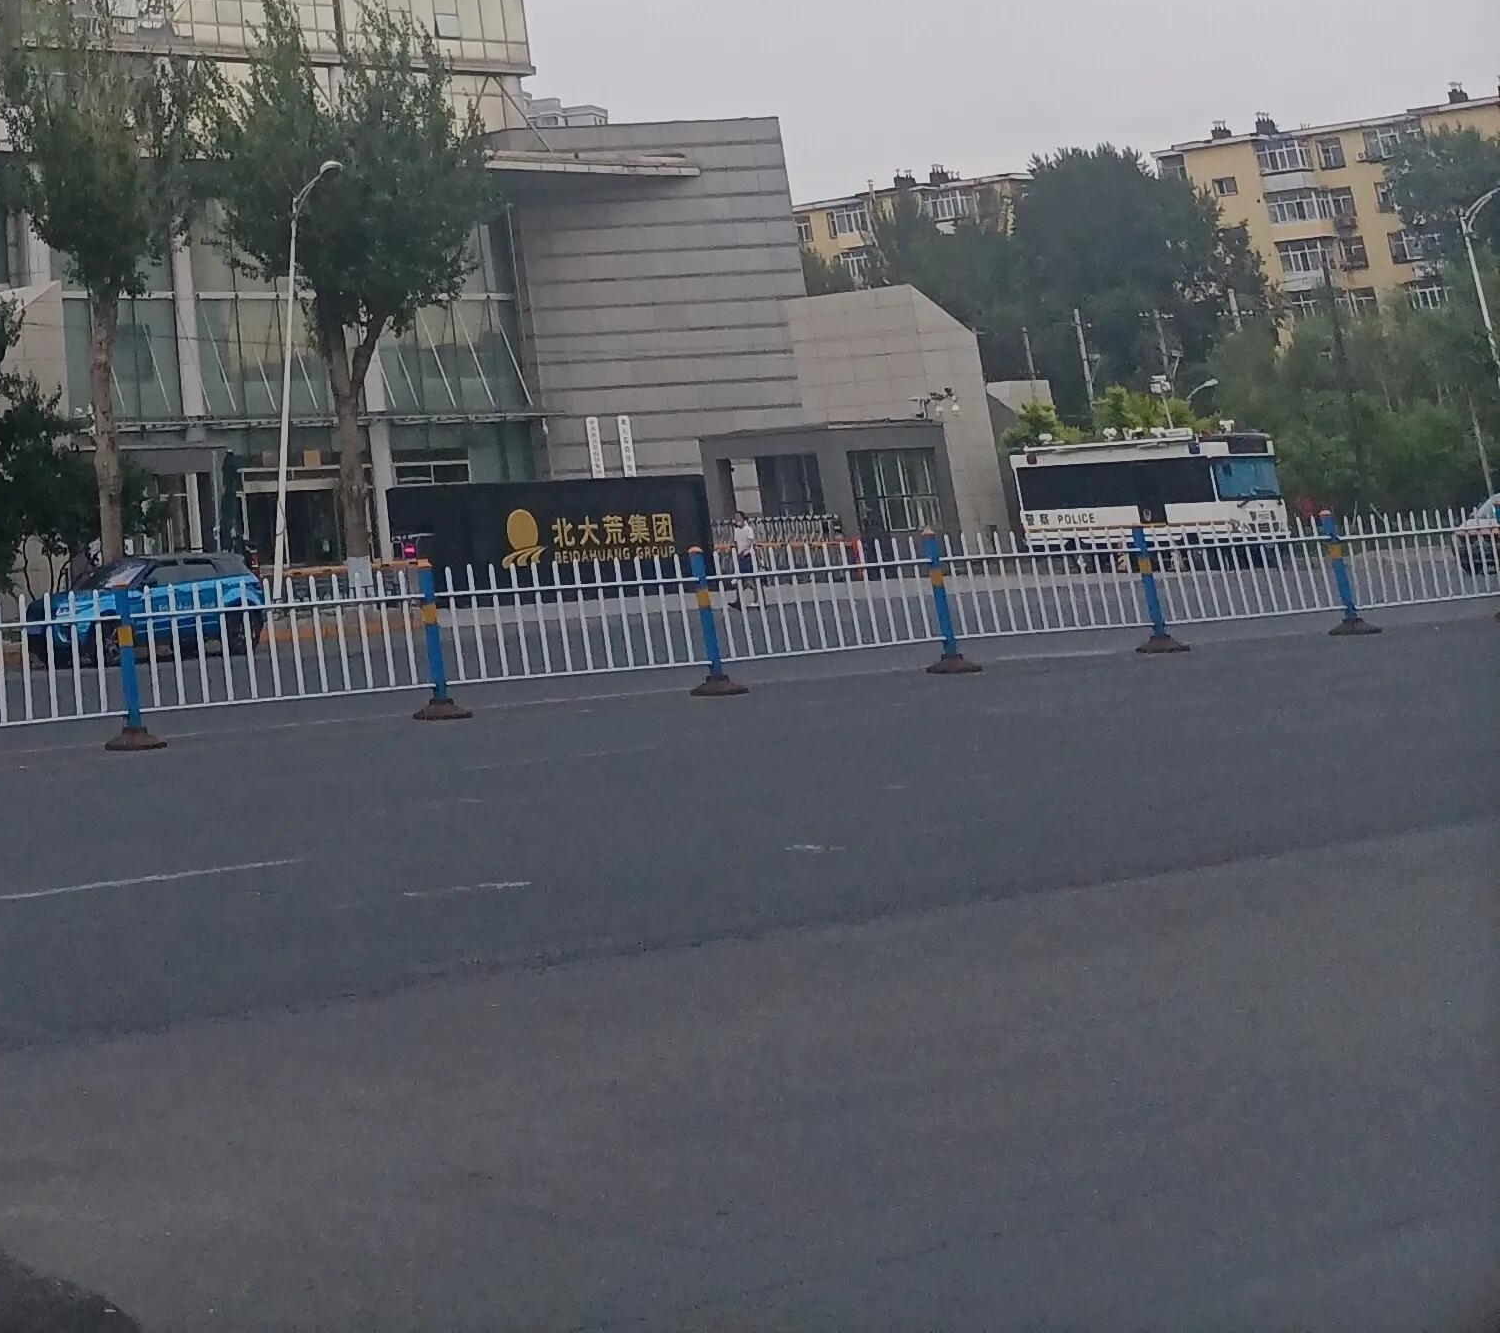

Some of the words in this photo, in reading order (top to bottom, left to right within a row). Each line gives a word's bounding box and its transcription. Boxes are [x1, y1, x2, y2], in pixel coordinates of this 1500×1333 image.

[1057, 513, 1096, 525] POLICE
[551, 514, 675, 548] 北大荒集团
[636, 545, 677, 561] GROUP
